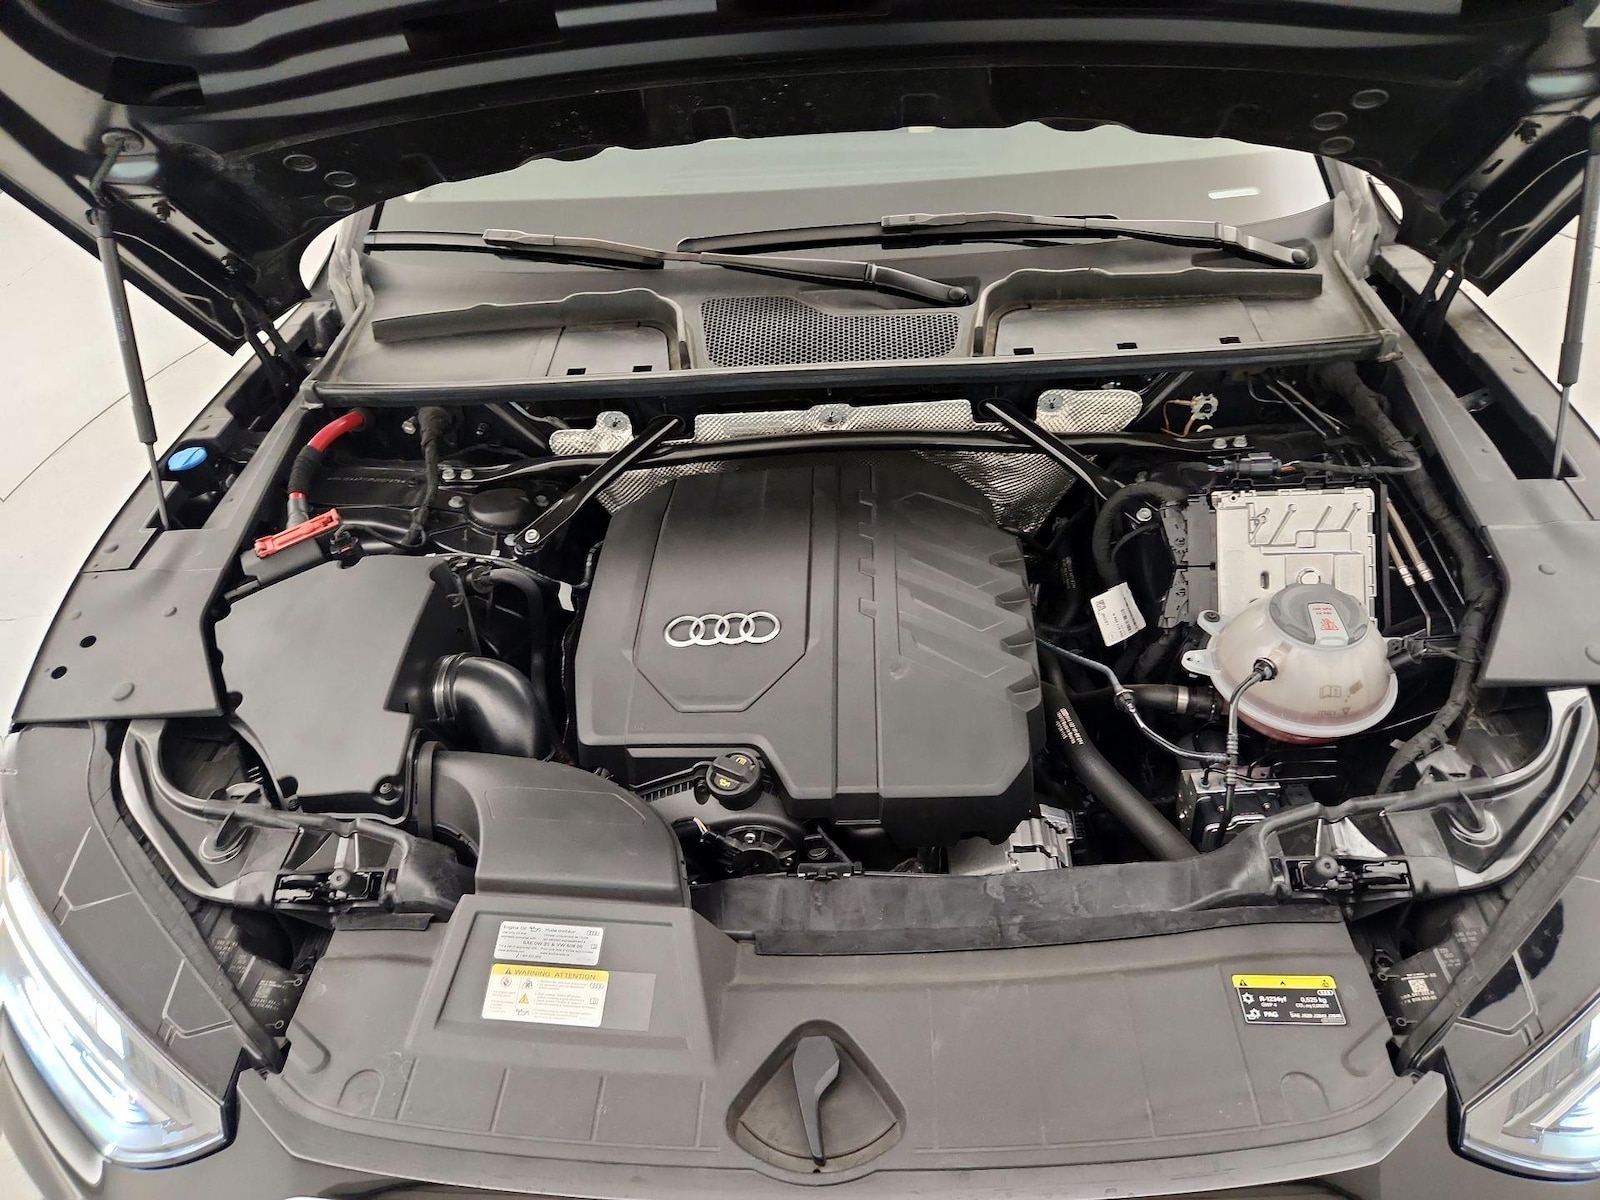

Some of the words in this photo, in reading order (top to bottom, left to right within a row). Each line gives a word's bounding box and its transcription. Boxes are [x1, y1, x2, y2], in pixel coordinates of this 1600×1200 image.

[514, 969, 551, 978] WARNING
[555, 971, 596, 981] ATTENTION
[1263, 1010, 1279, 1018] PAG
